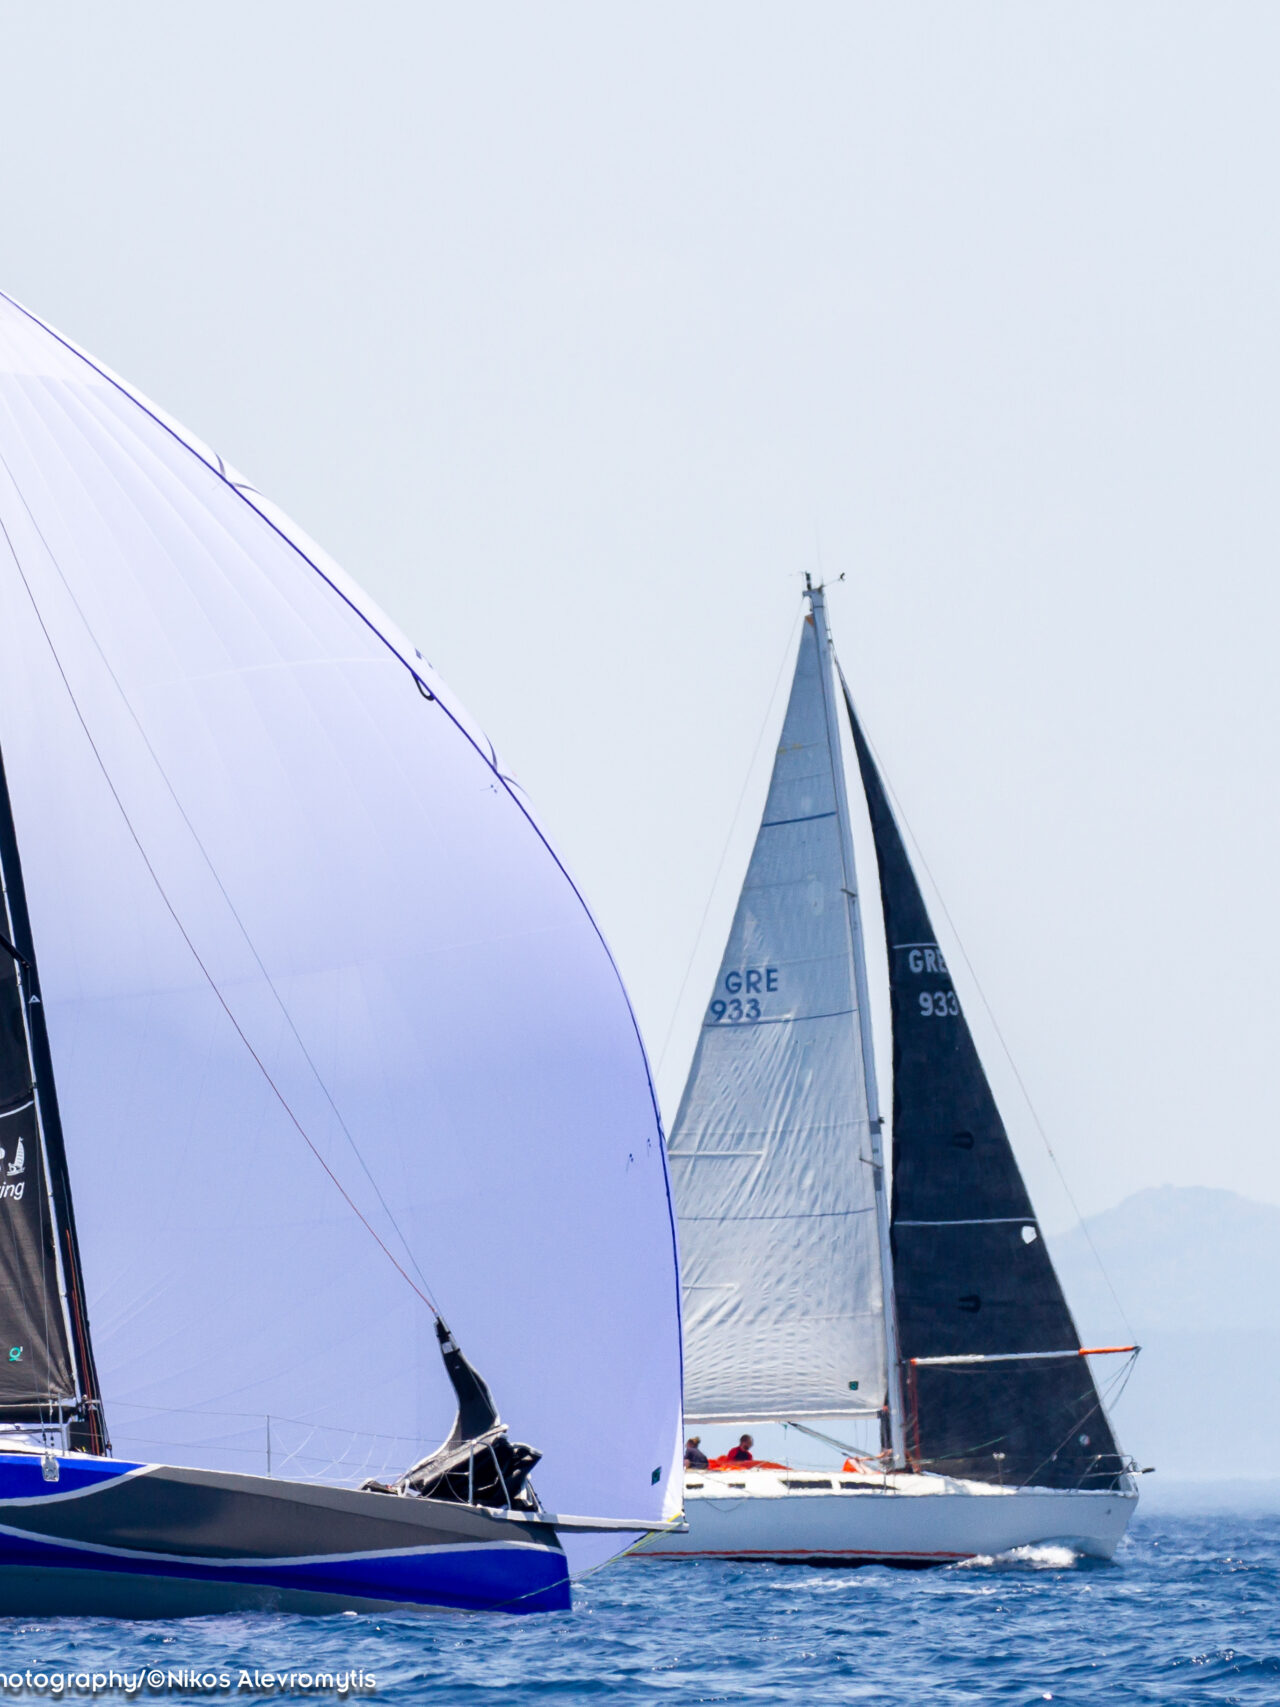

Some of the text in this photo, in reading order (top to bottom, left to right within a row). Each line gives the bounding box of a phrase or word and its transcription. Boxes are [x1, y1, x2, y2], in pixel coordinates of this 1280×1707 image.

[725, 967, 778, 994] GRE
[709, 998, 761, 1023] 933
[918, 990, 960, 1017] 933
